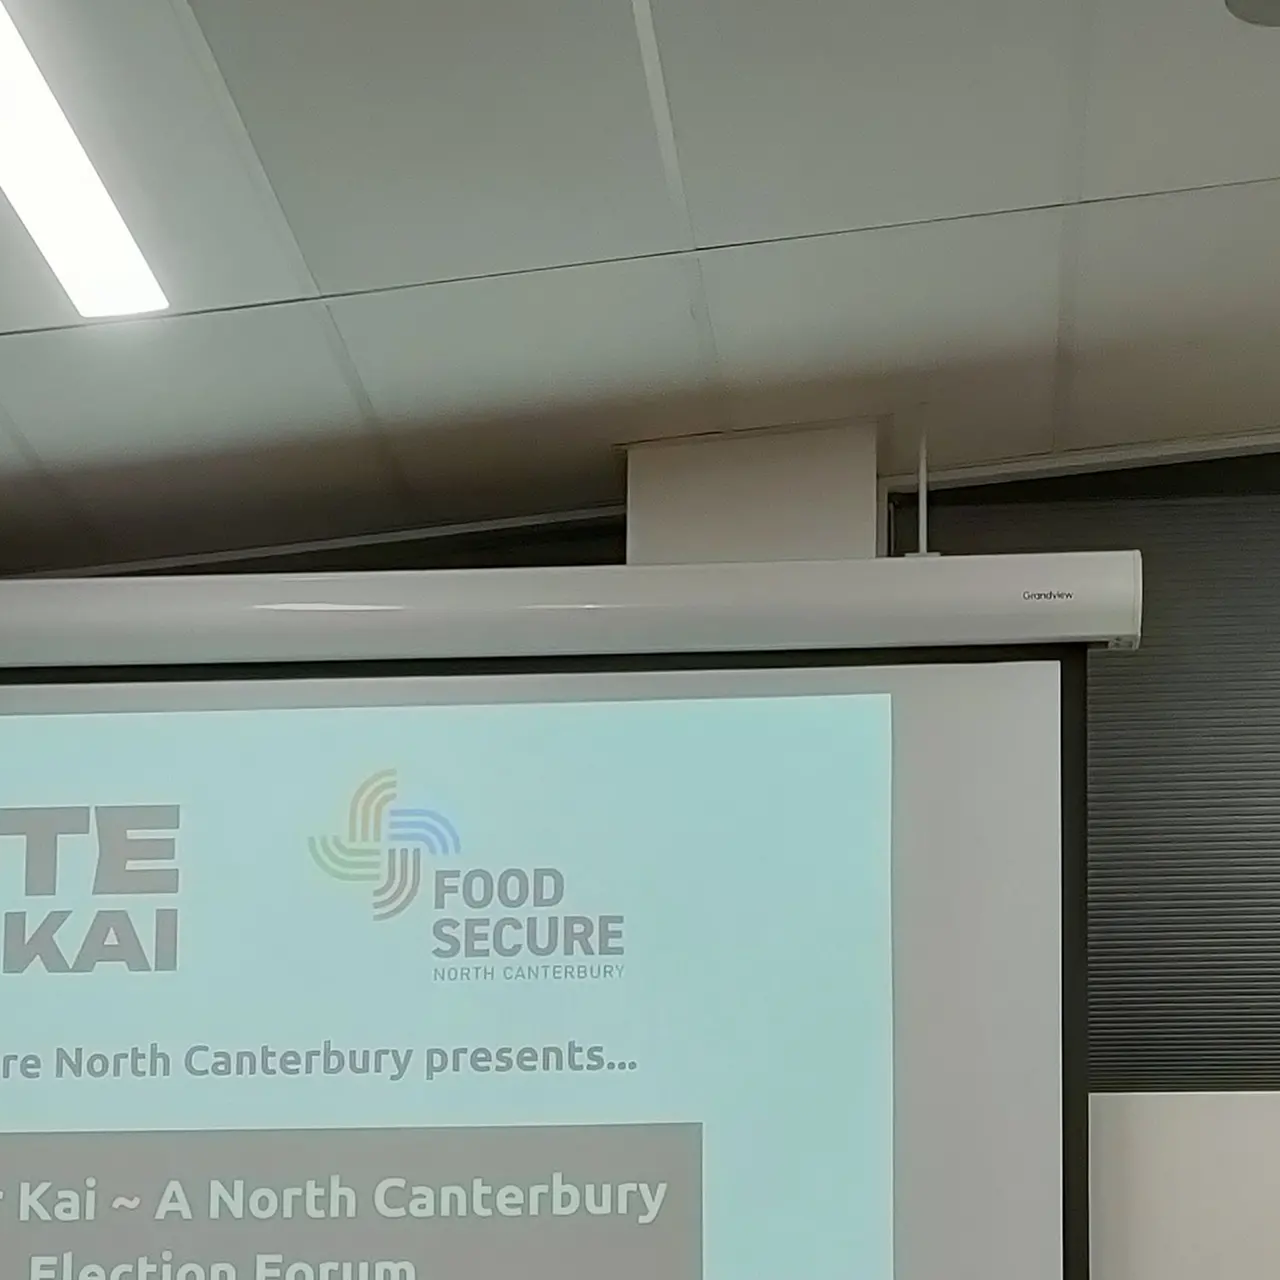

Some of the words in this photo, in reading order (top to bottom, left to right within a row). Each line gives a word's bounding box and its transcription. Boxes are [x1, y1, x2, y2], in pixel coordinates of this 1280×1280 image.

[1022, 591, 1074, 600] Grandview
[433, 867, 565, 910] FOOD
[3, 907, 179, 974] KAI
[431, 914, 625, 959] SECURE
[433, 965, 495, 982] NORTH
[502, 963, 626, 981] CANTERBURY
[55, 1042, 171, 1079] North
[184, 1038, 414, 1082] Canterbury
[425, 1038, 637, 1081] presents...
[19, 1176, 97, 1221] Kai
[154, 1179, 193, 1220] A
[209, 1174, 357, 1220] North
[374, 1171, 668, 1224] Canterbury
